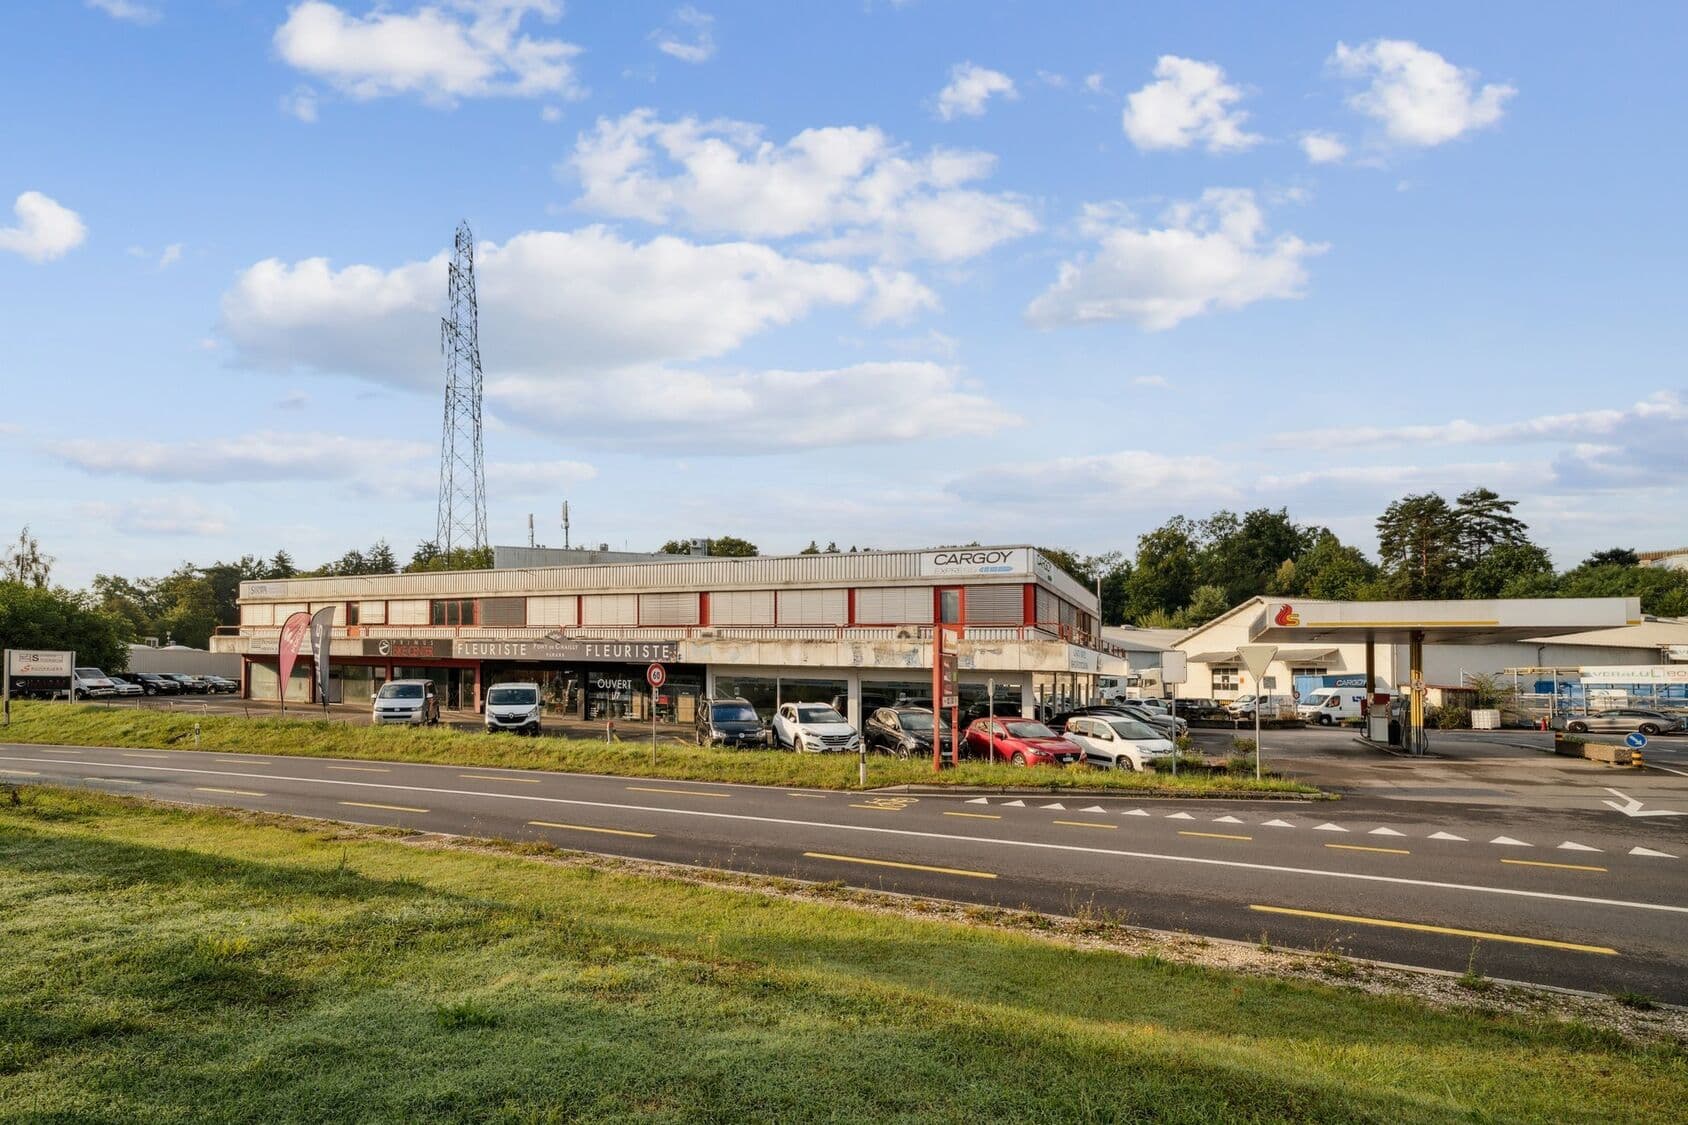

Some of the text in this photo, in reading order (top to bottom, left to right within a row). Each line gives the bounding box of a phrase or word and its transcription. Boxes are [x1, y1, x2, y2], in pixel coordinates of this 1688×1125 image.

[934, 551, 1014, 566] CARGOY
[457, 643, 525, 656] FLEURISTE
[586, 644, 669, 658] FLEURISTE
[652, 671, 661, 680] 60
[597, 678, 632, 689] OUVERT
